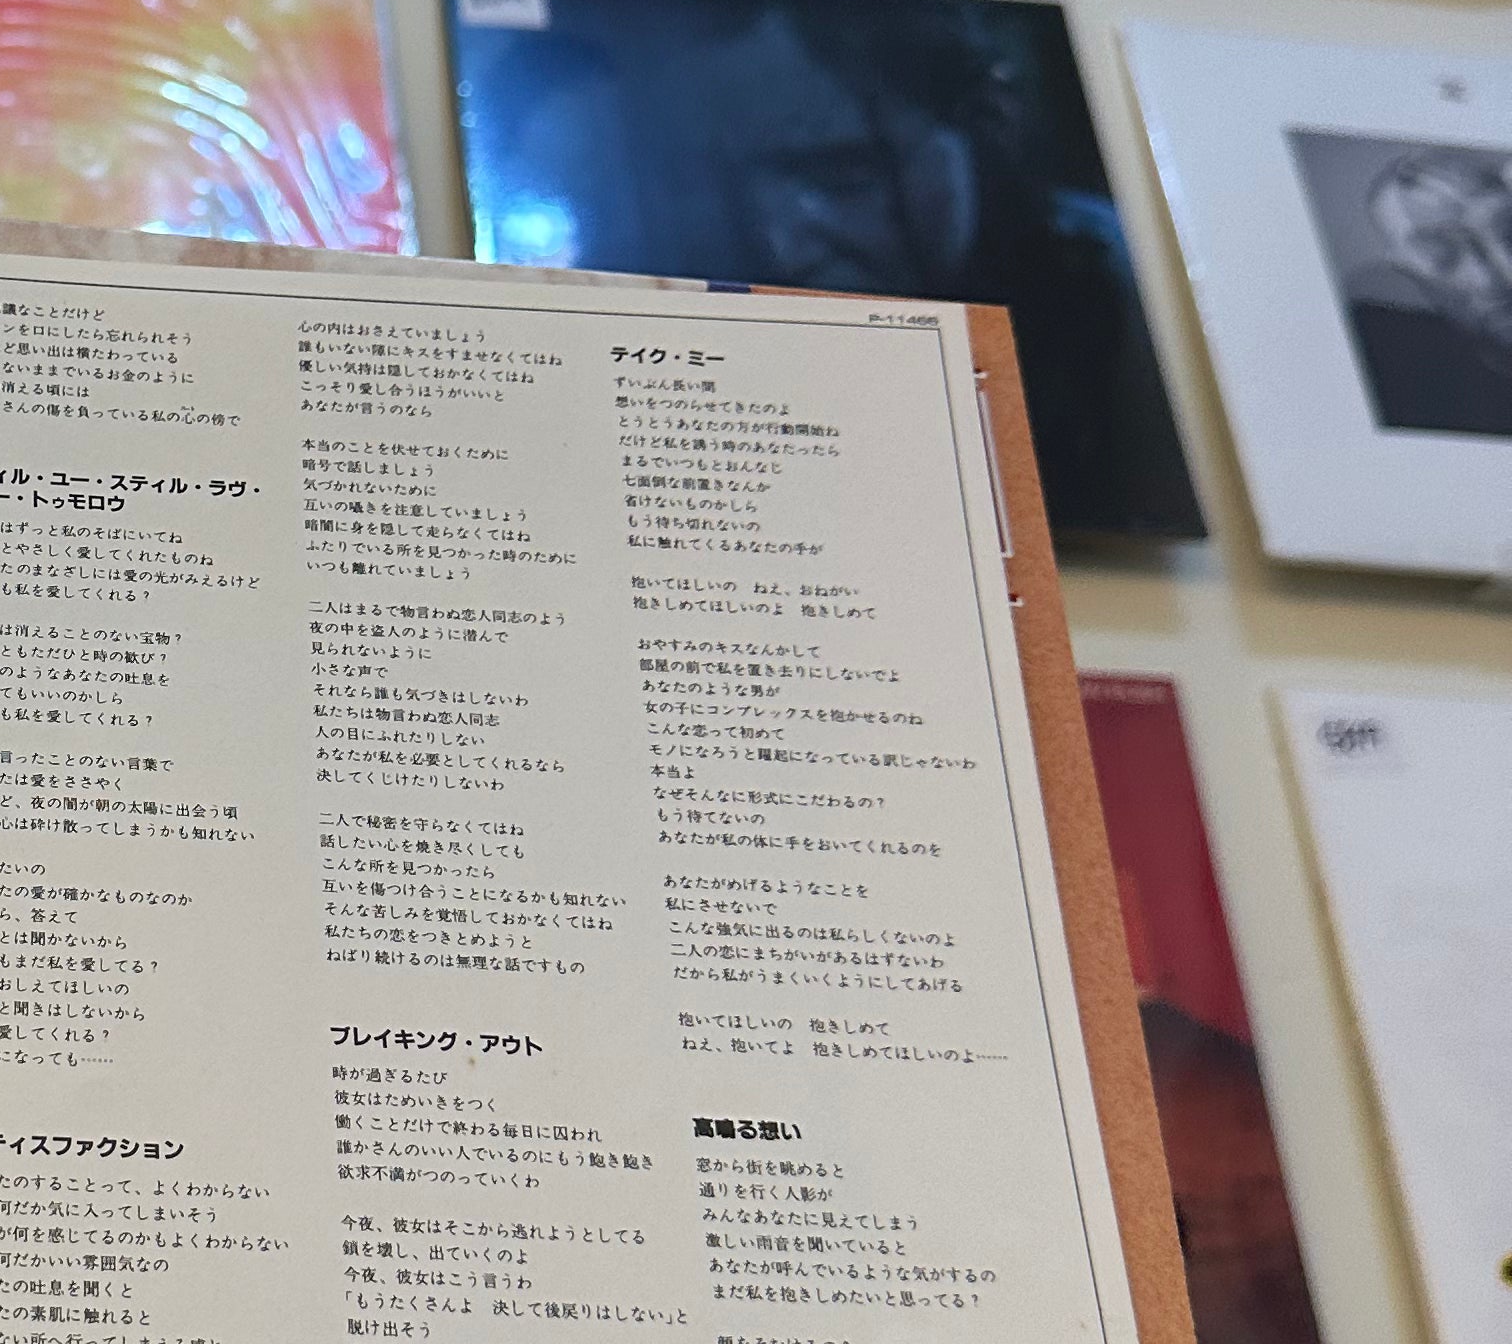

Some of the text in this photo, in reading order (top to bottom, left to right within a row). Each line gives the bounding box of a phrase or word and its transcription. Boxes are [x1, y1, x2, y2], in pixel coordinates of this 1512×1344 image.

[608, 345, 726, 368] テイク・ミー
[299, 397, 432, 418] あなたが言うのなら
[309, 640, 432, 660] 見られないように
[309, 660, 389, 679] 小さな声で
[640, 678, 781, 698] あなたのような男が
[648, 762, 695, 780] 本当よ
[656, 806, 766, 826] もう待てないの
[663, 895, 778, 916] 私にさせないで
[331, 1063, 448, 1086] 時が過ぎるたび
[697, 1180, 833, 1203] 通りを行く人影が
